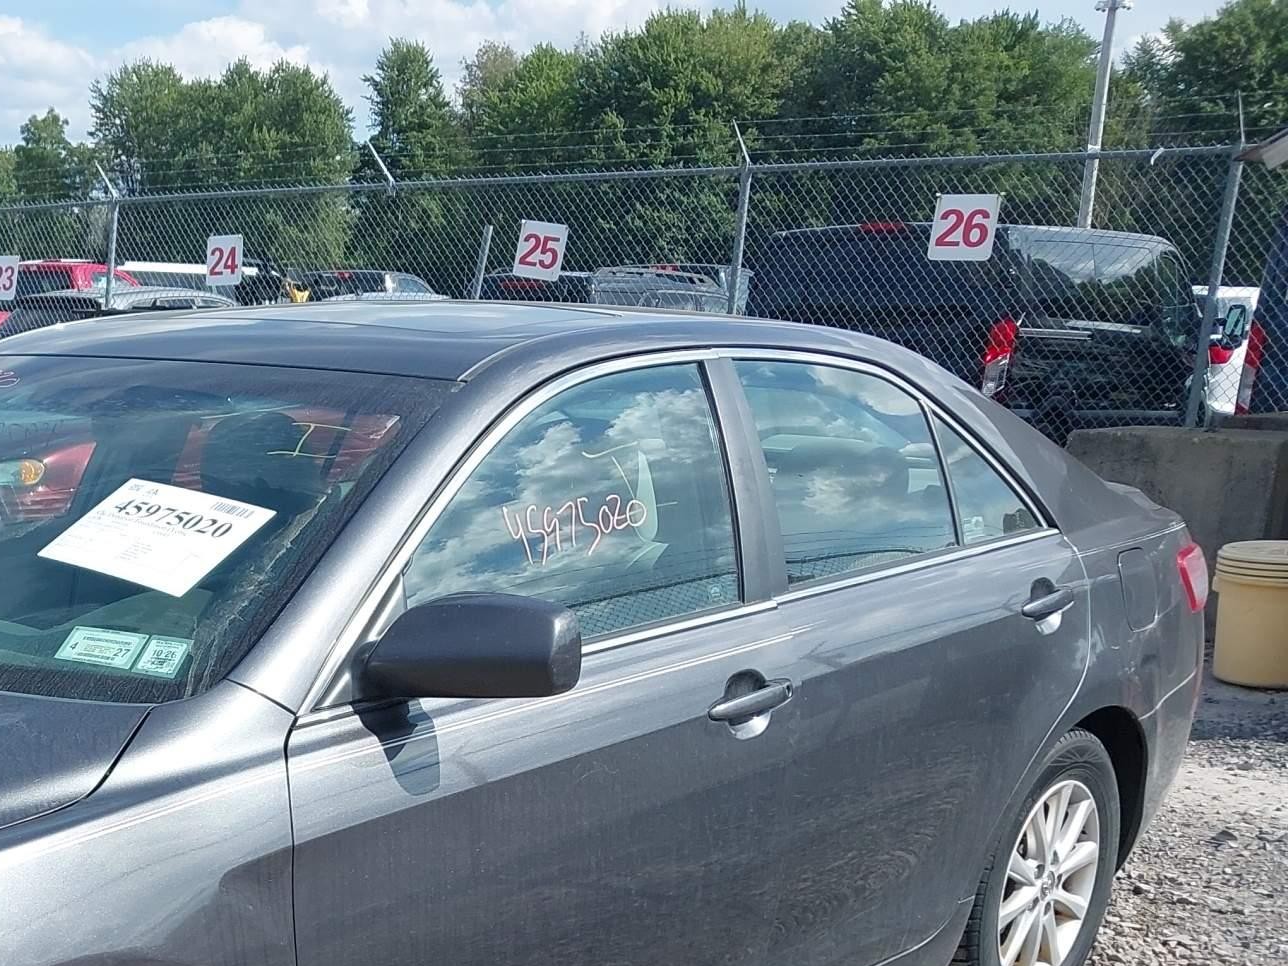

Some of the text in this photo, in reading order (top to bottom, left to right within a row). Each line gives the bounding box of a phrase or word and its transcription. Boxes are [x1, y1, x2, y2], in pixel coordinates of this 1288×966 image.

[934, 208, 991, 248] 26
[209, 246, 238, 276] 24
[518, 233, 560, 270] 25
[112, 498, 233, 539] 45975020
[502, 494, 648, 566] 45975020
[113, 647, 131, 659] 27
